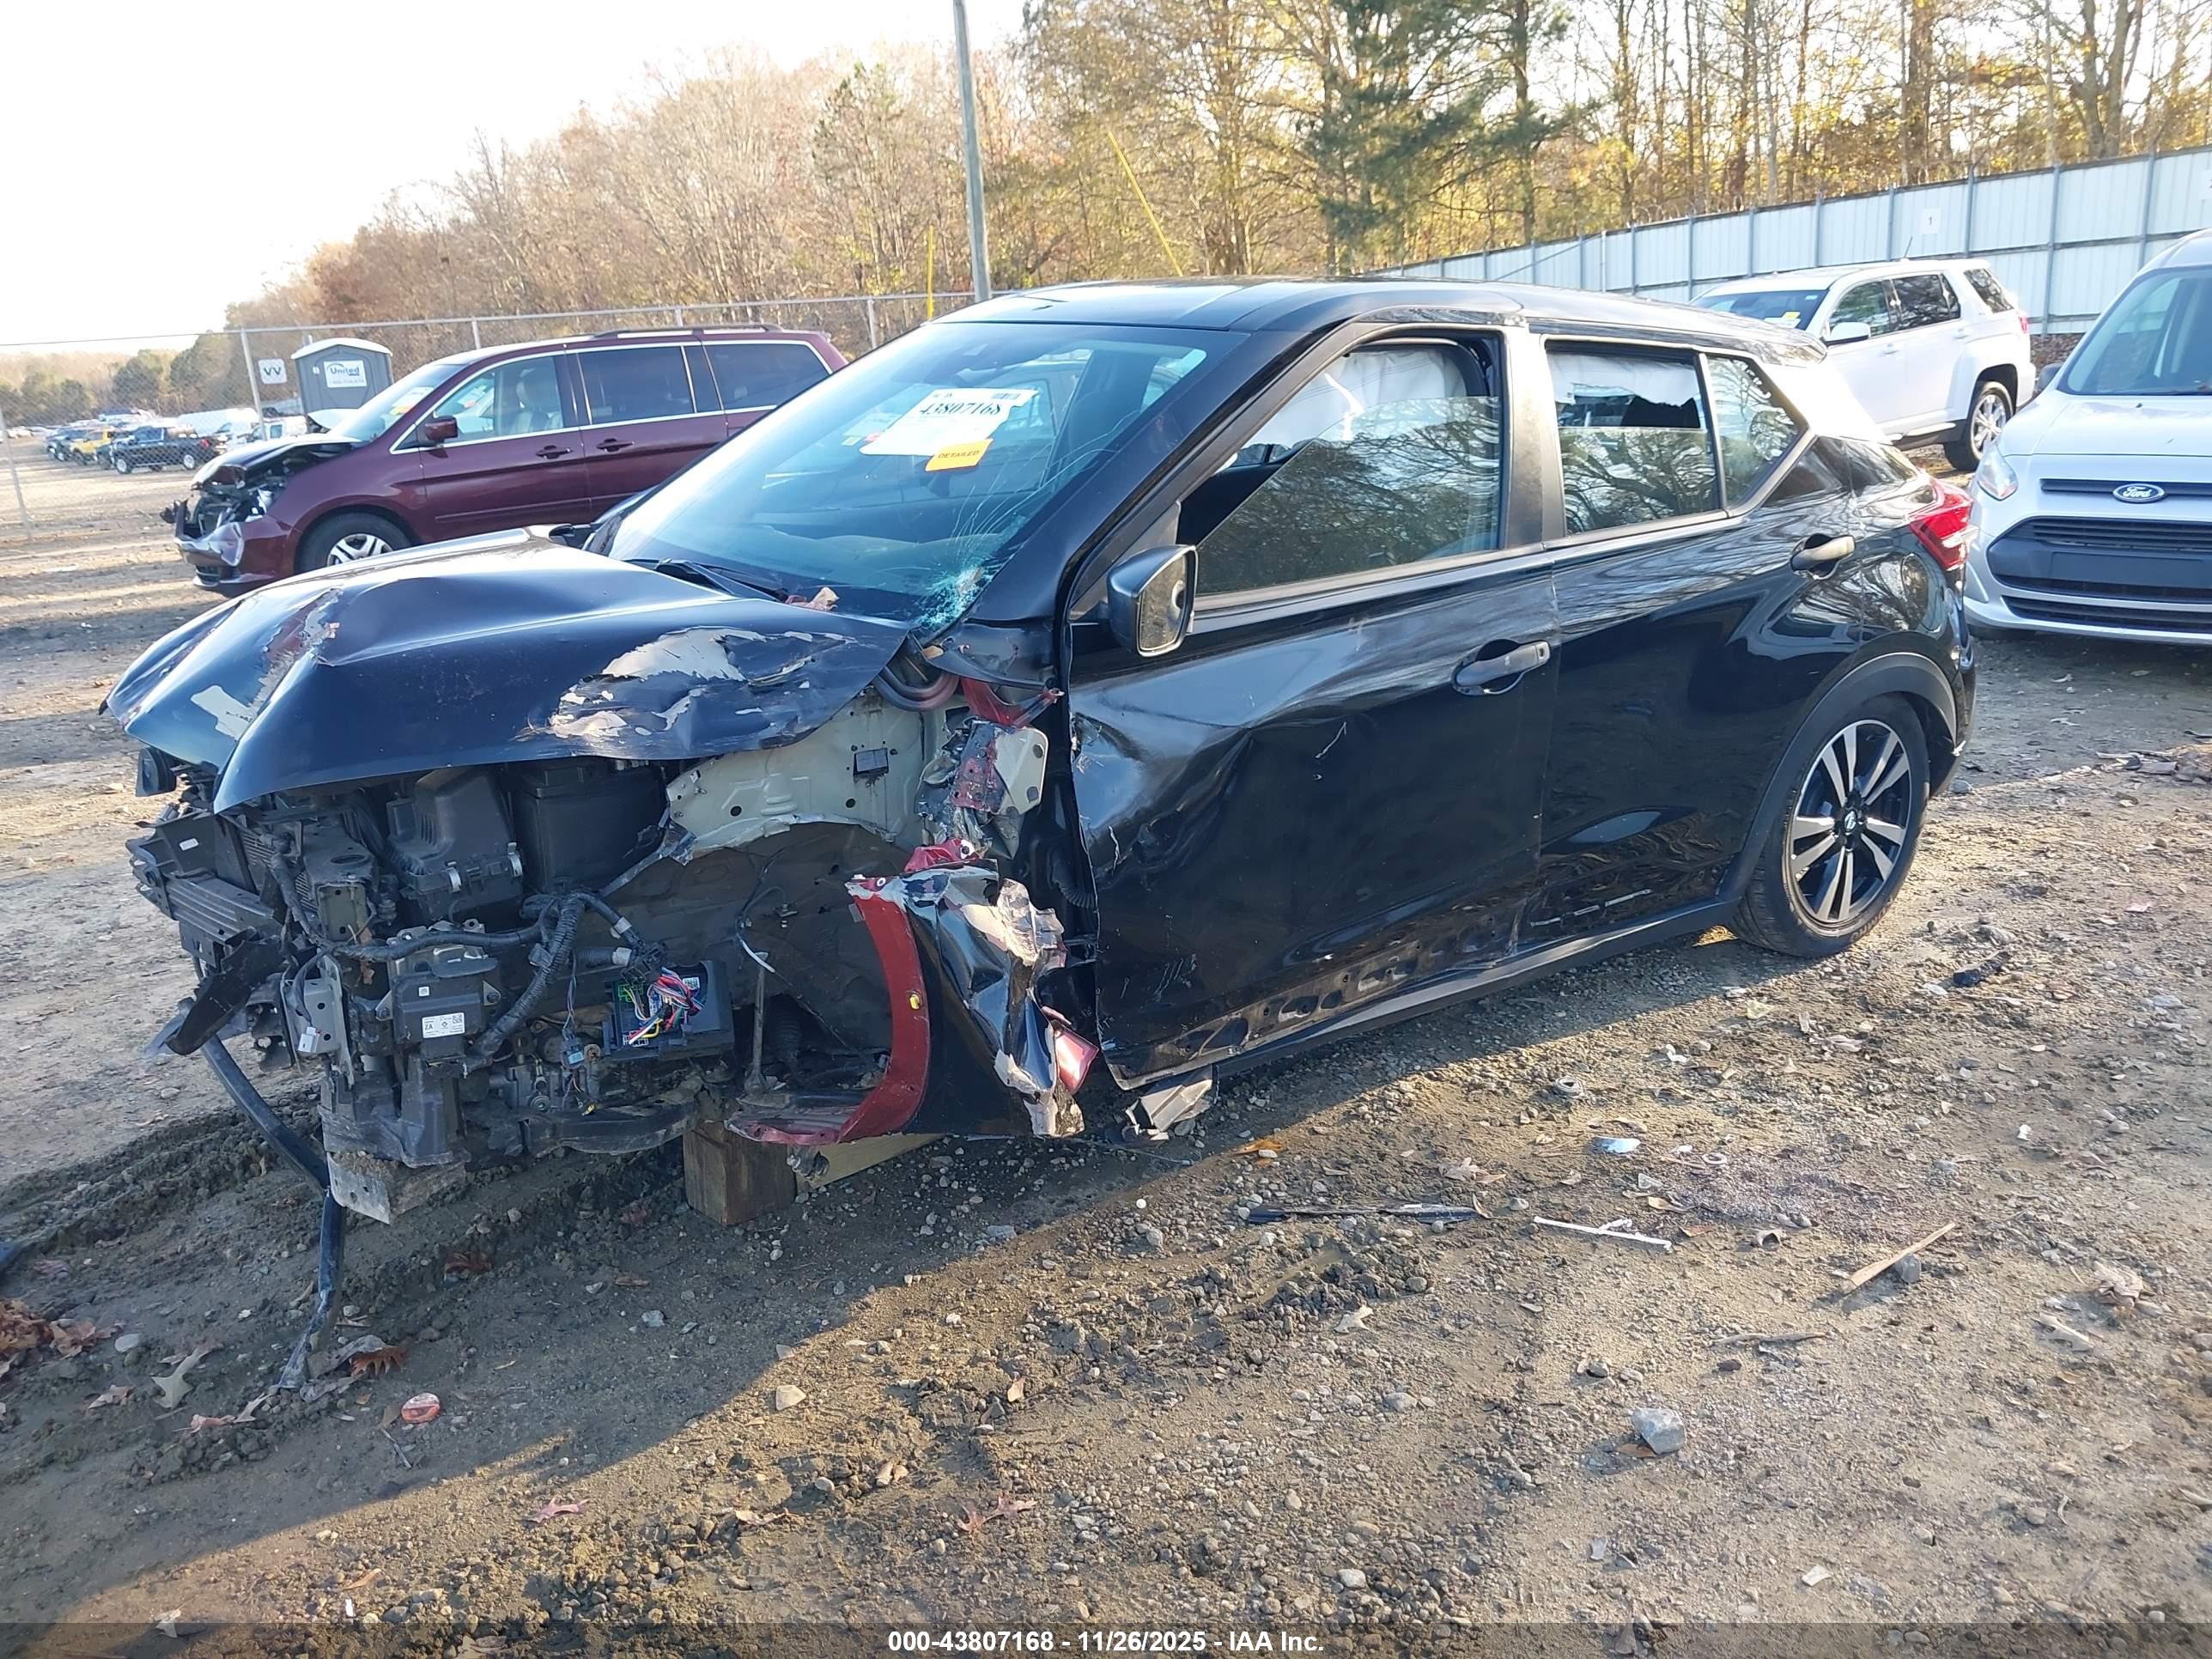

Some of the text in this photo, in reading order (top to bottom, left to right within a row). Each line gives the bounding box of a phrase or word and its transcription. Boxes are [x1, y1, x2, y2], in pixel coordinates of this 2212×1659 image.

[1928, 216, 1933, 226] 1
[330, 366, 360, 374] United
[919, 401, 1002, 416] 43807168
[937, 449, 981, 459] DETAILED
[2122, 486, 2153, 498] Ford
